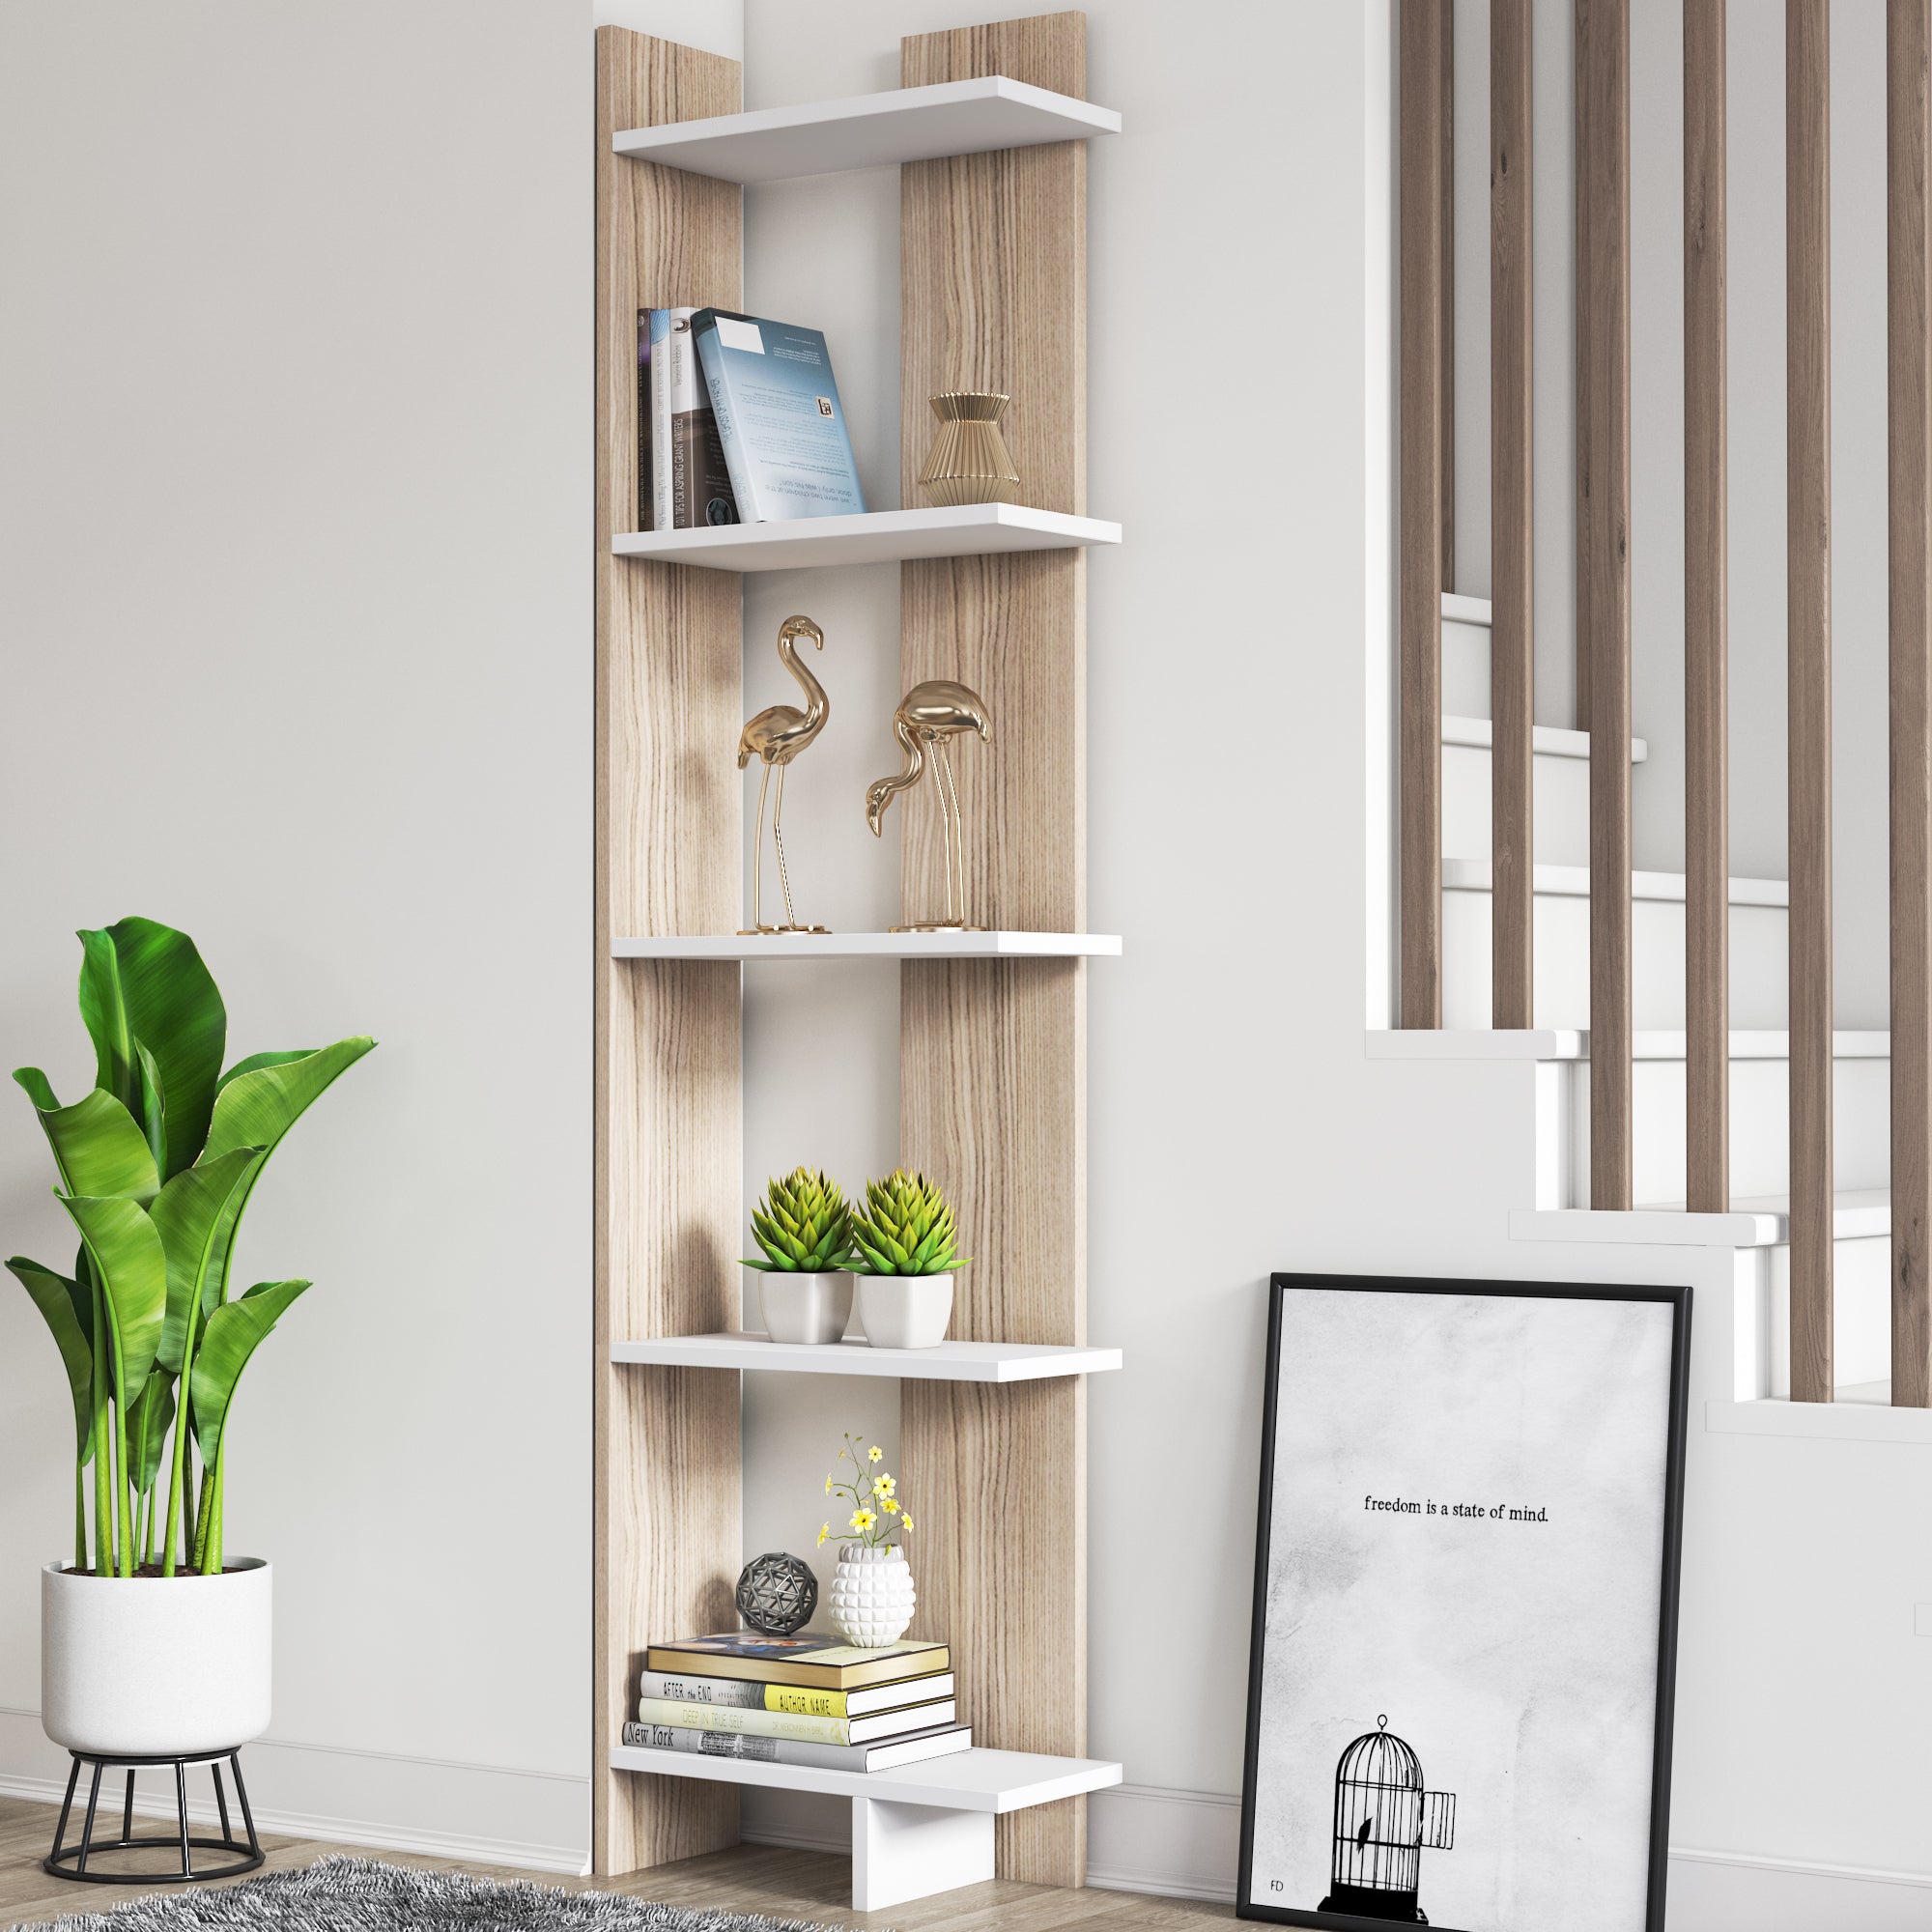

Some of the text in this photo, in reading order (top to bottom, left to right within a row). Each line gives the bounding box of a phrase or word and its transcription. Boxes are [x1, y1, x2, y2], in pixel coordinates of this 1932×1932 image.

[674, 419, 683, 442] WRITERS
[674, 442, 684, 464] GRANT
[675, 464, 684, 490] ASPIRING
[675, 491, 684, 502] FOR
[675, 503, 684, 514] TIPS
[1364, 1495, 1548, 1522] freedom is a state of mind.
[663, 1682, 684, 1698] AFTER
[697, 1686, 711, 1701] END
[780, 1694, 831, 1716] AUTHOR NAME
[682, 1709, 744, 1729] DEEP IN TRUE SELF
[628, 1723, 673, 1747] New York
[1270, 1880, 1283, 1891] FD
